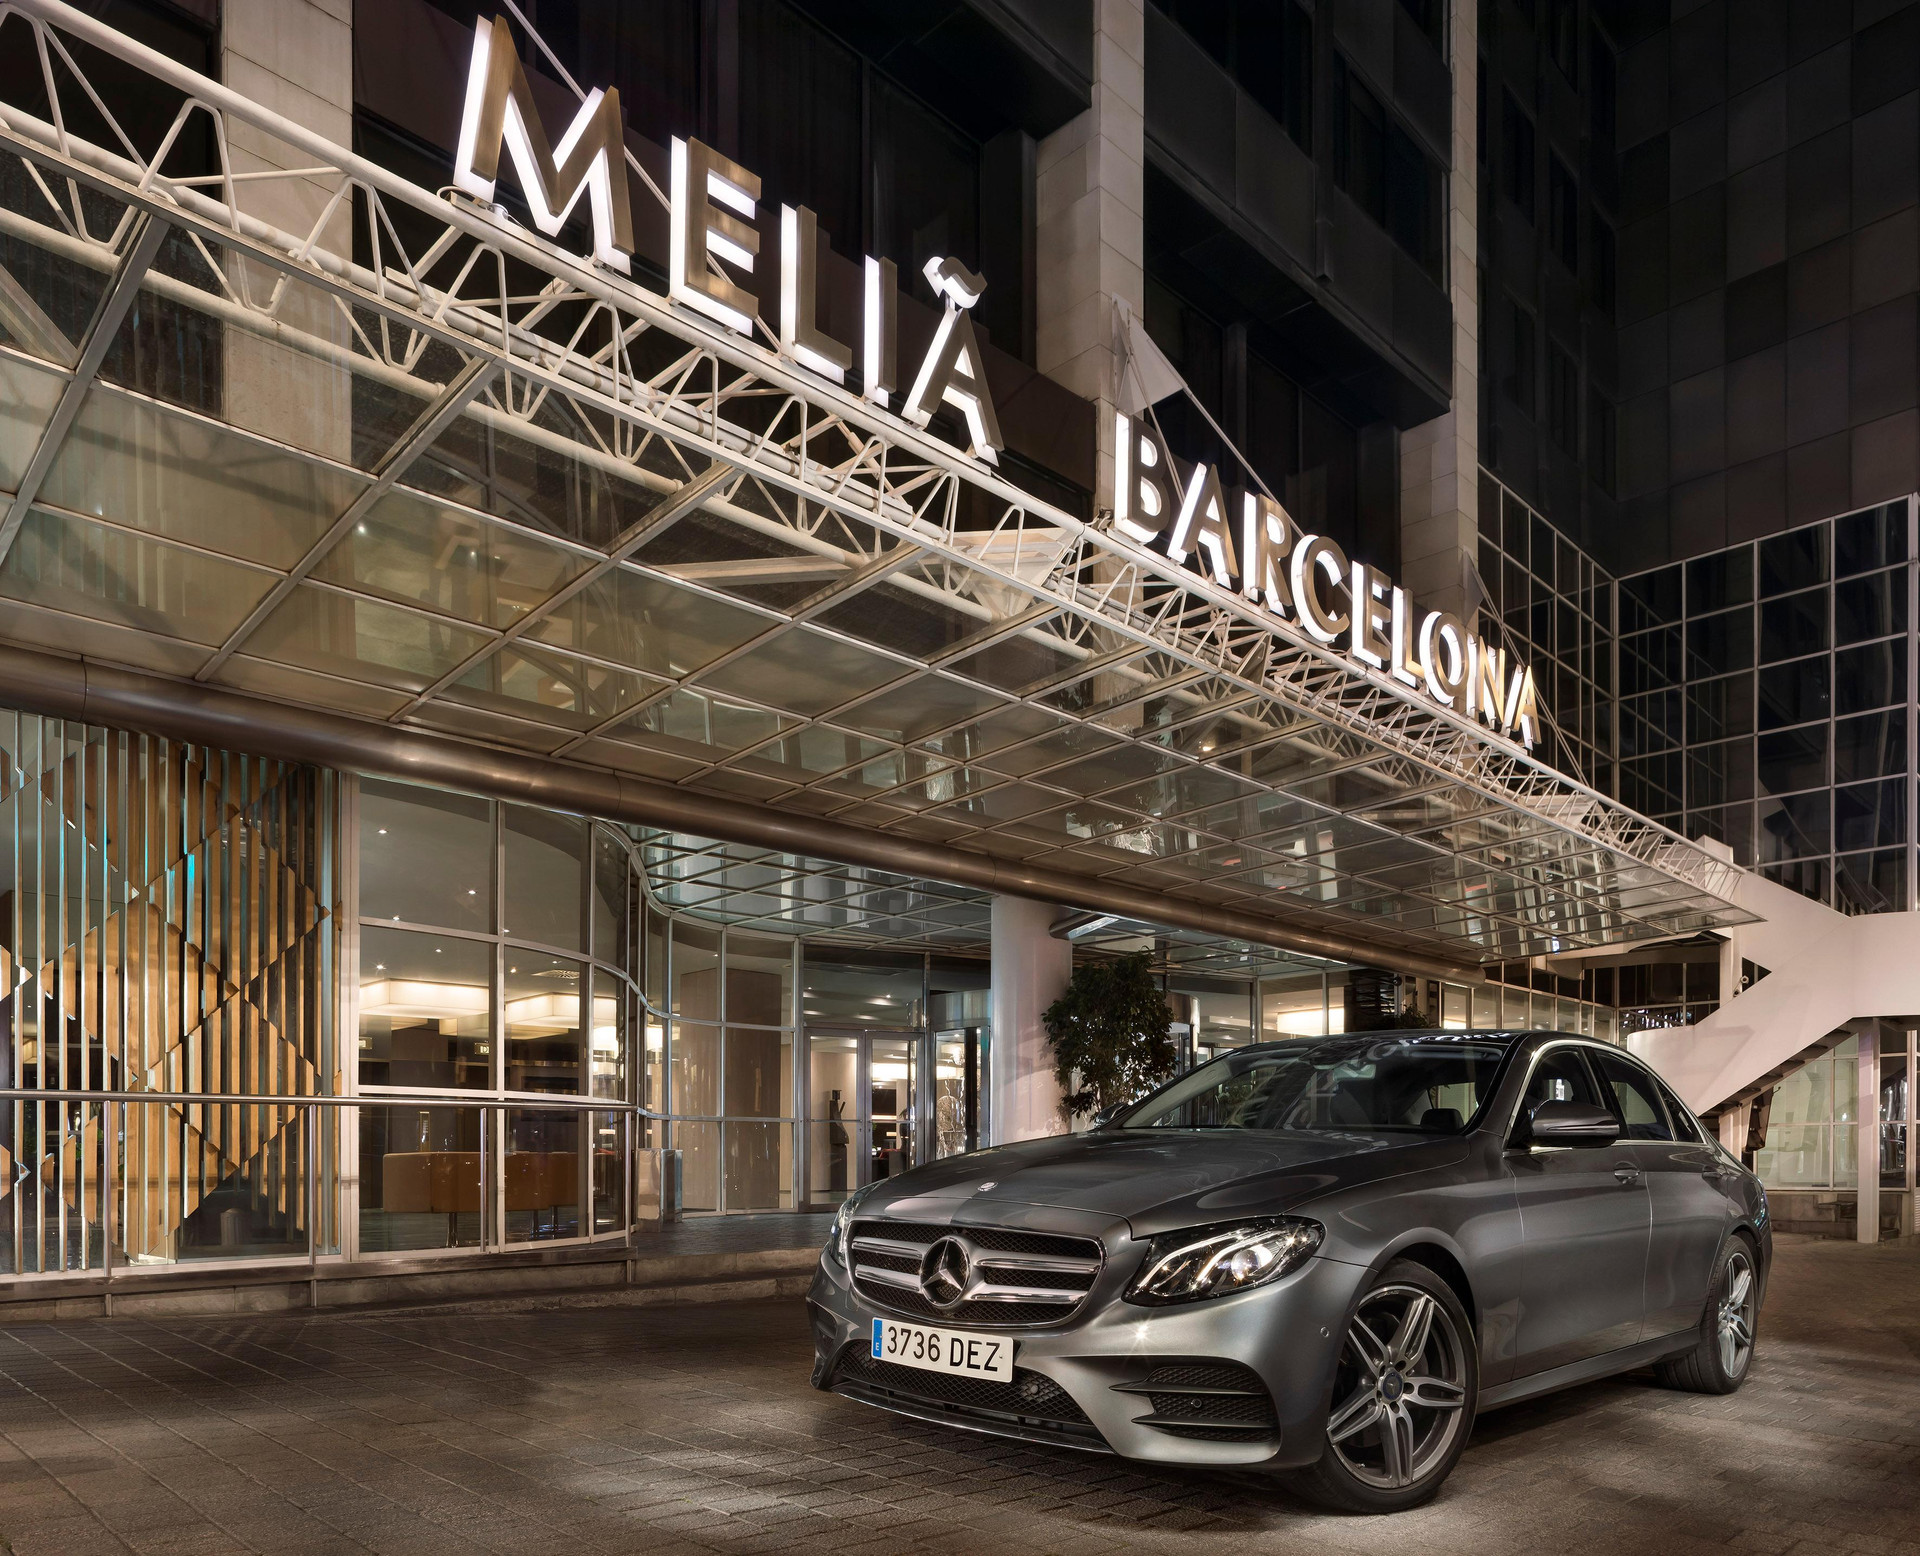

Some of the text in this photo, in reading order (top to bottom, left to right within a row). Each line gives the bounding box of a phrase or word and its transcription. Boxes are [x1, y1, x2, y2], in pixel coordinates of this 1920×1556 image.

[1114, 411, 1542, 750] BARCELONA
[875, 1341, 880, 1351] E
[887, 1326, 1001, 1372] 3736 DEZ
